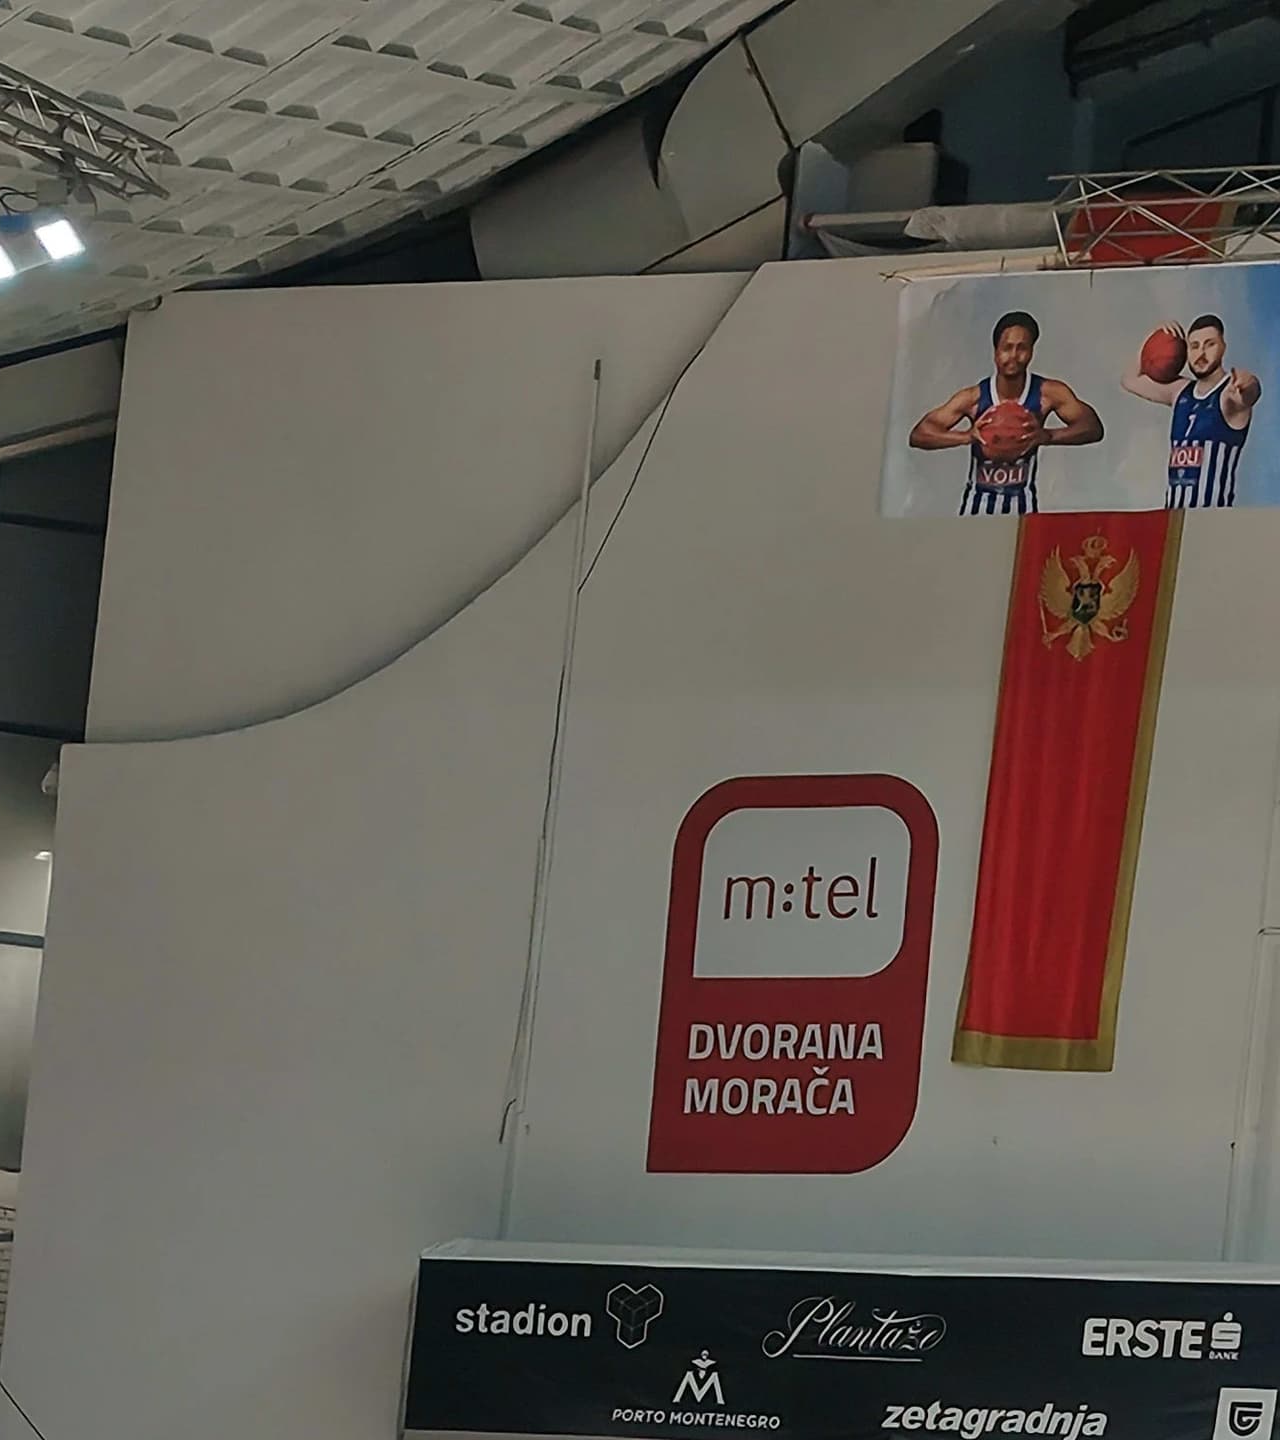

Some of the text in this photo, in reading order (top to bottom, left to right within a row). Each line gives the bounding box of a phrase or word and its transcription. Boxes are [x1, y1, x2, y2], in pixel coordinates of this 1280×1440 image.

[980, 467, 1024, 485] VOLI
[1170, 448, 1200, 467] VOLI
[723, 856, 880, 921] m:tel
[688, 1022, 884, 1061] DVORANA
[683, 1065, 856, 1116] MORAČA
[454, 1302, 593, 1339] stadion
[1081, 1317, 1205, 1360] ERSTE
[611, 1408, 781, 1431] PORTO MONTENEGRO
